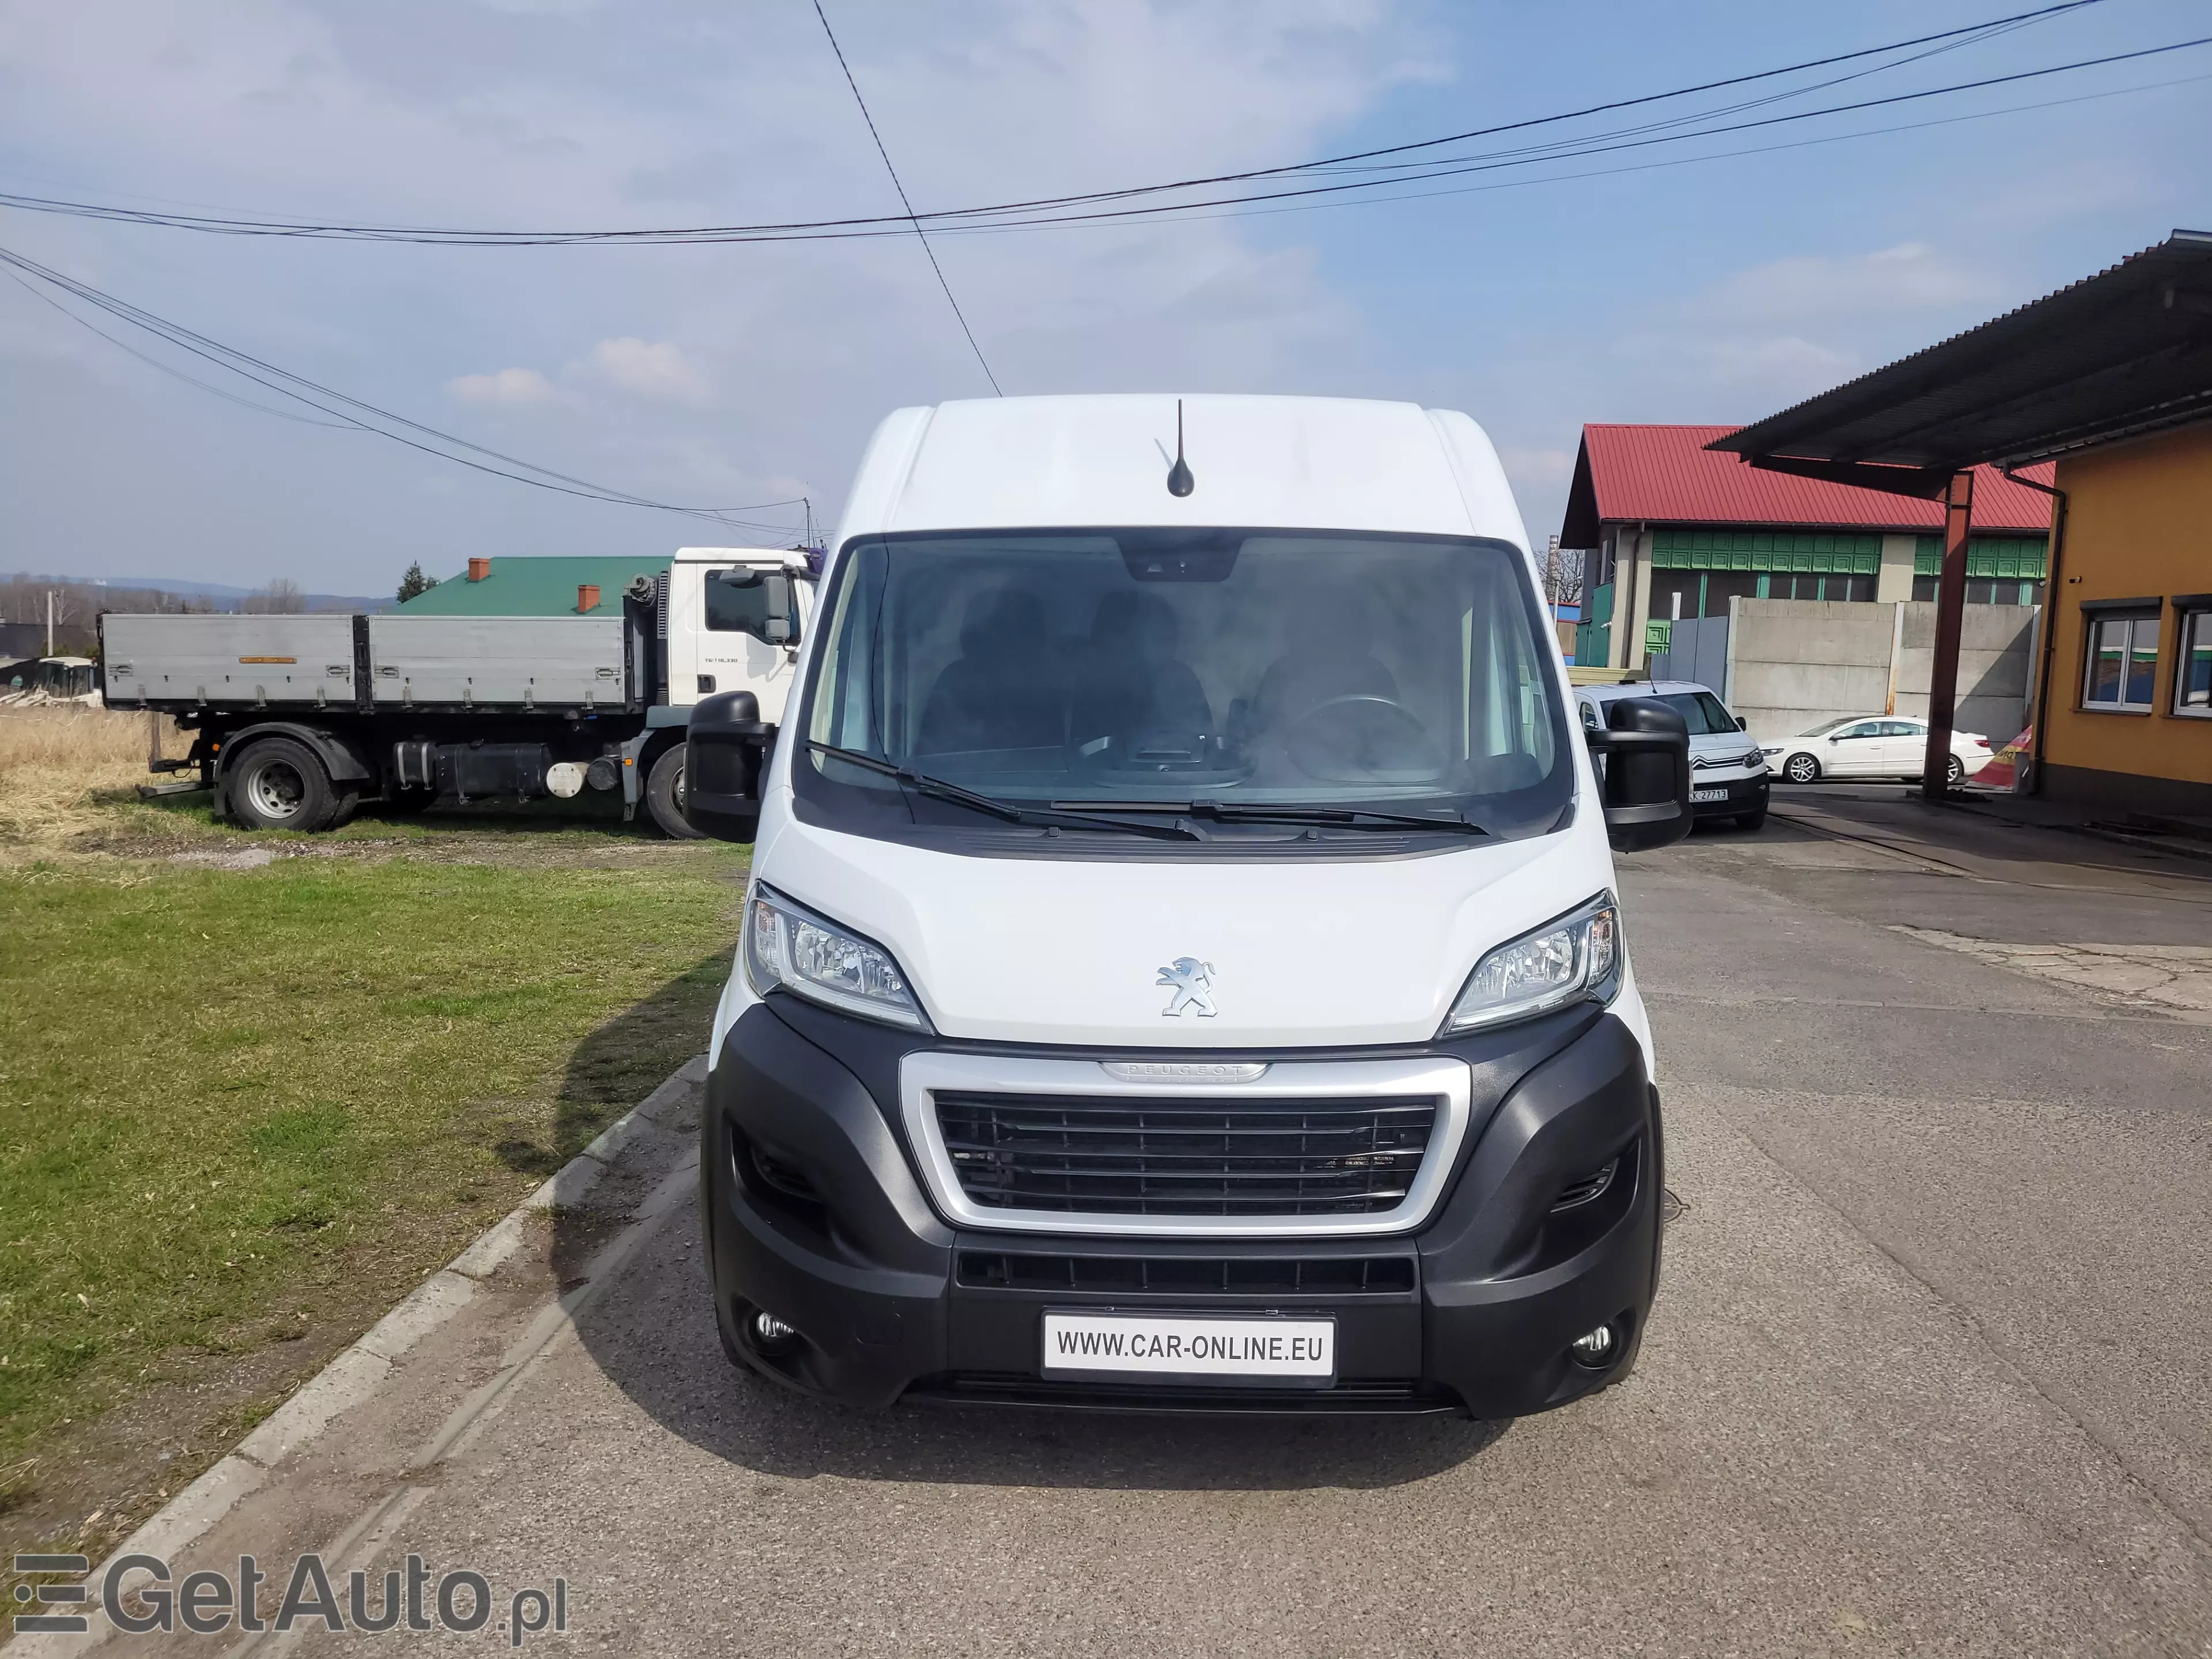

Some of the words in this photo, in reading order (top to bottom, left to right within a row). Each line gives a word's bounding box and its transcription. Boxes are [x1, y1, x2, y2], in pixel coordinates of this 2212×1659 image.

[1701, 790, 1726, 800] 27713
[1127, 1065, 1242, 1075] PEUGEOT
[1057, 1331, 1323, 1361] WWW.CAR-ONLINE.EU
